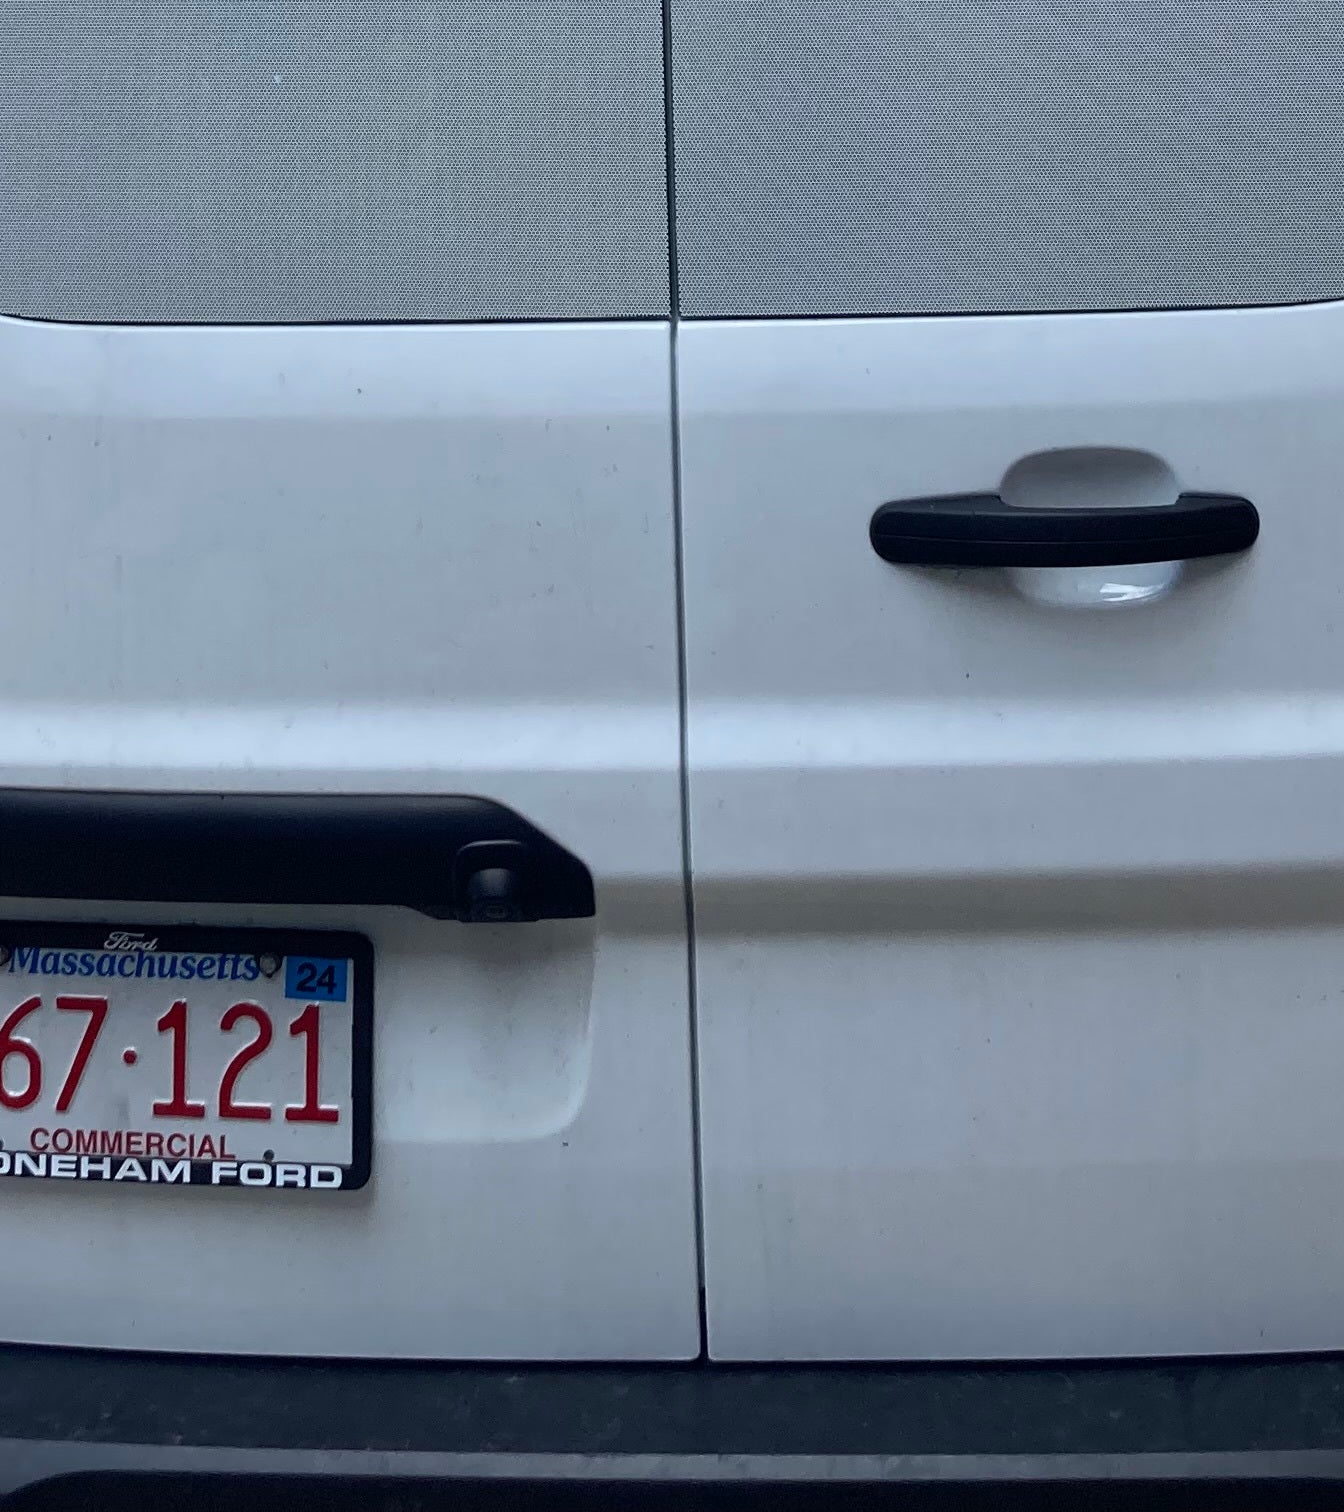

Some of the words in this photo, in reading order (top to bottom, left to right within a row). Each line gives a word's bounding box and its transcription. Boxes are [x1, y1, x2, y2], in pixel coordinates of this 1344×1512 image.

[103, 931, 159, 951] Ford
[9, 944, 260, 982] Massachusetts
[296, 962, 338, 995] 24
[29, 1127, 236, 1160] COMMERCIAL
[210, 1161, 343, 1190] FORD
